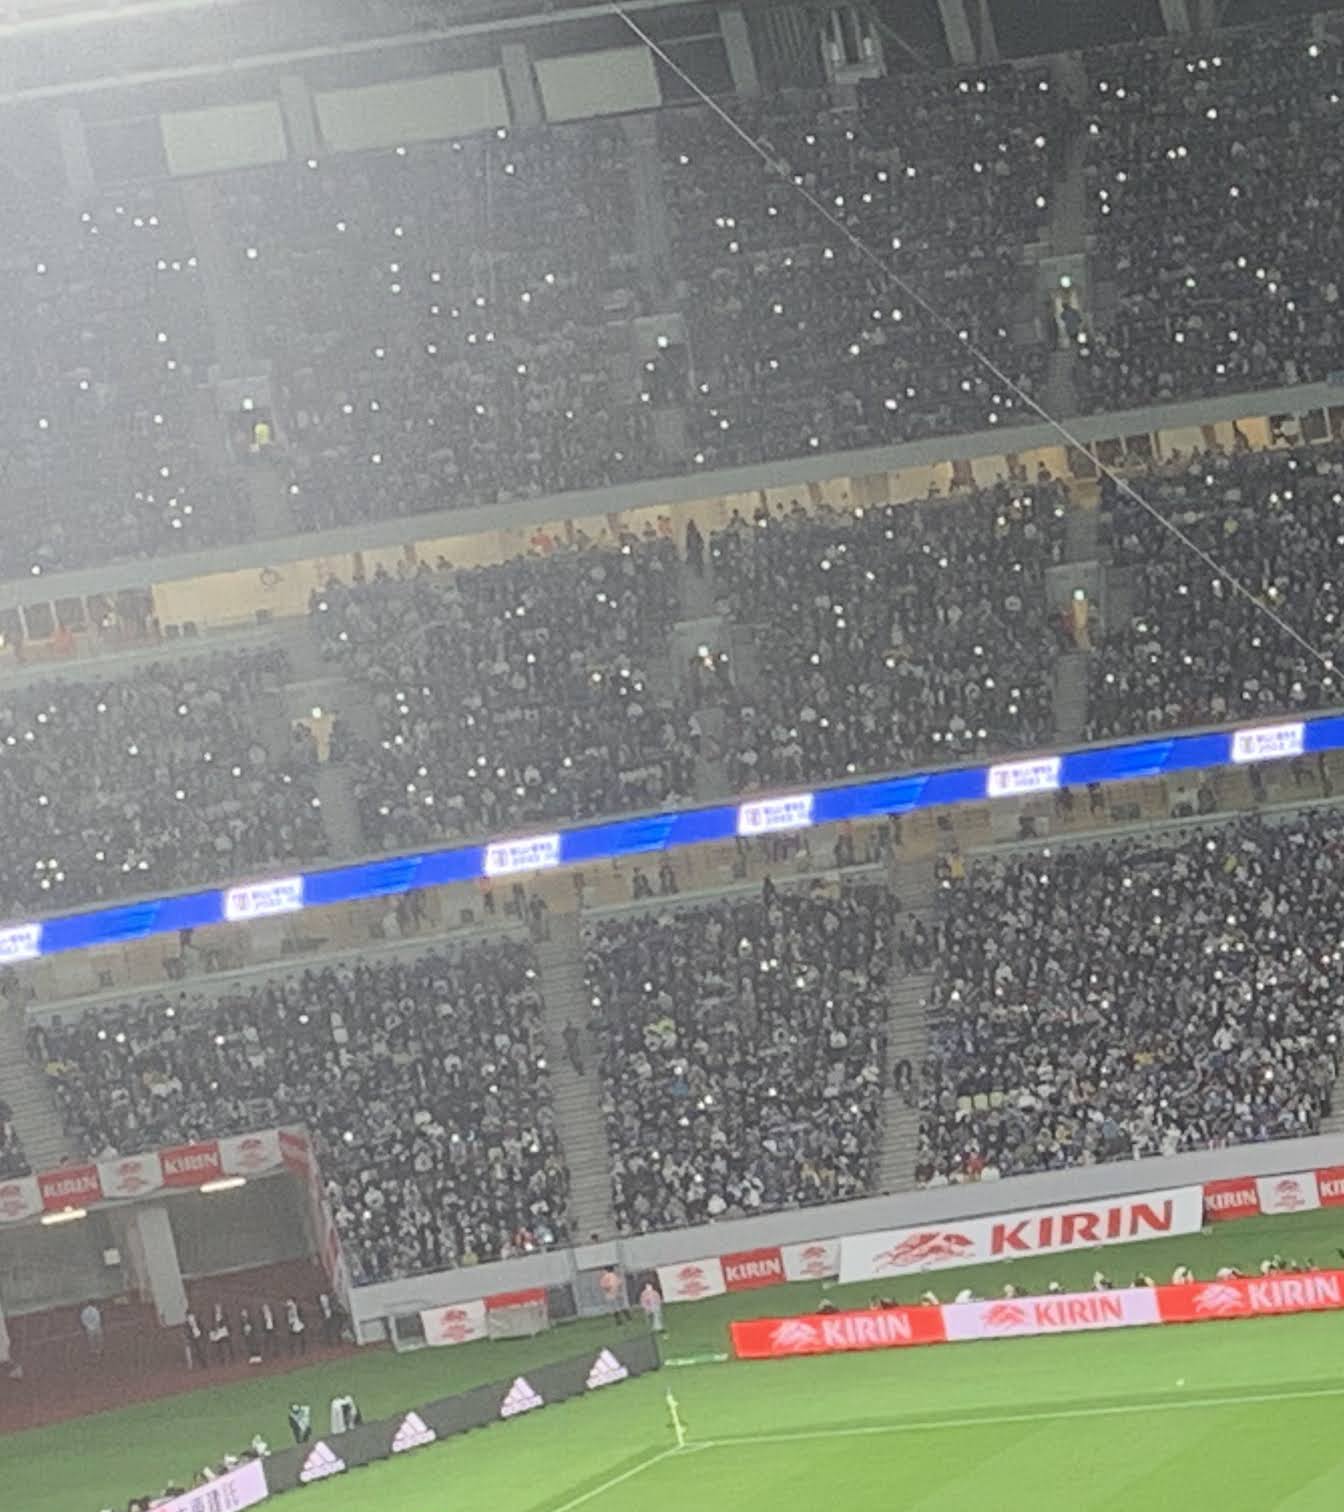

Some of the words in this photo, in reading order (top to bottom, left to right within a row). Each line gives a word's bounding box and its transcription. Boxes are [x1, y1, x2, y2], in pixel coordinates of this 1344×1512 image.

[163, 1152, 218, 1176] KIRIN
[43, 1174, 97, 1197] KIRIN
[1206, 1188, 1257, 1211] KIRIN
[991, 1200, 1174, 1255] KIRIN
[725, 1257, 782, 1281] KIRIN
[1248, 1276, 1340, 1310] KIRIN
[1034, 1294, 1124, 1328] KIRIN
[822, 1312, 912, 1346] KIRIN
